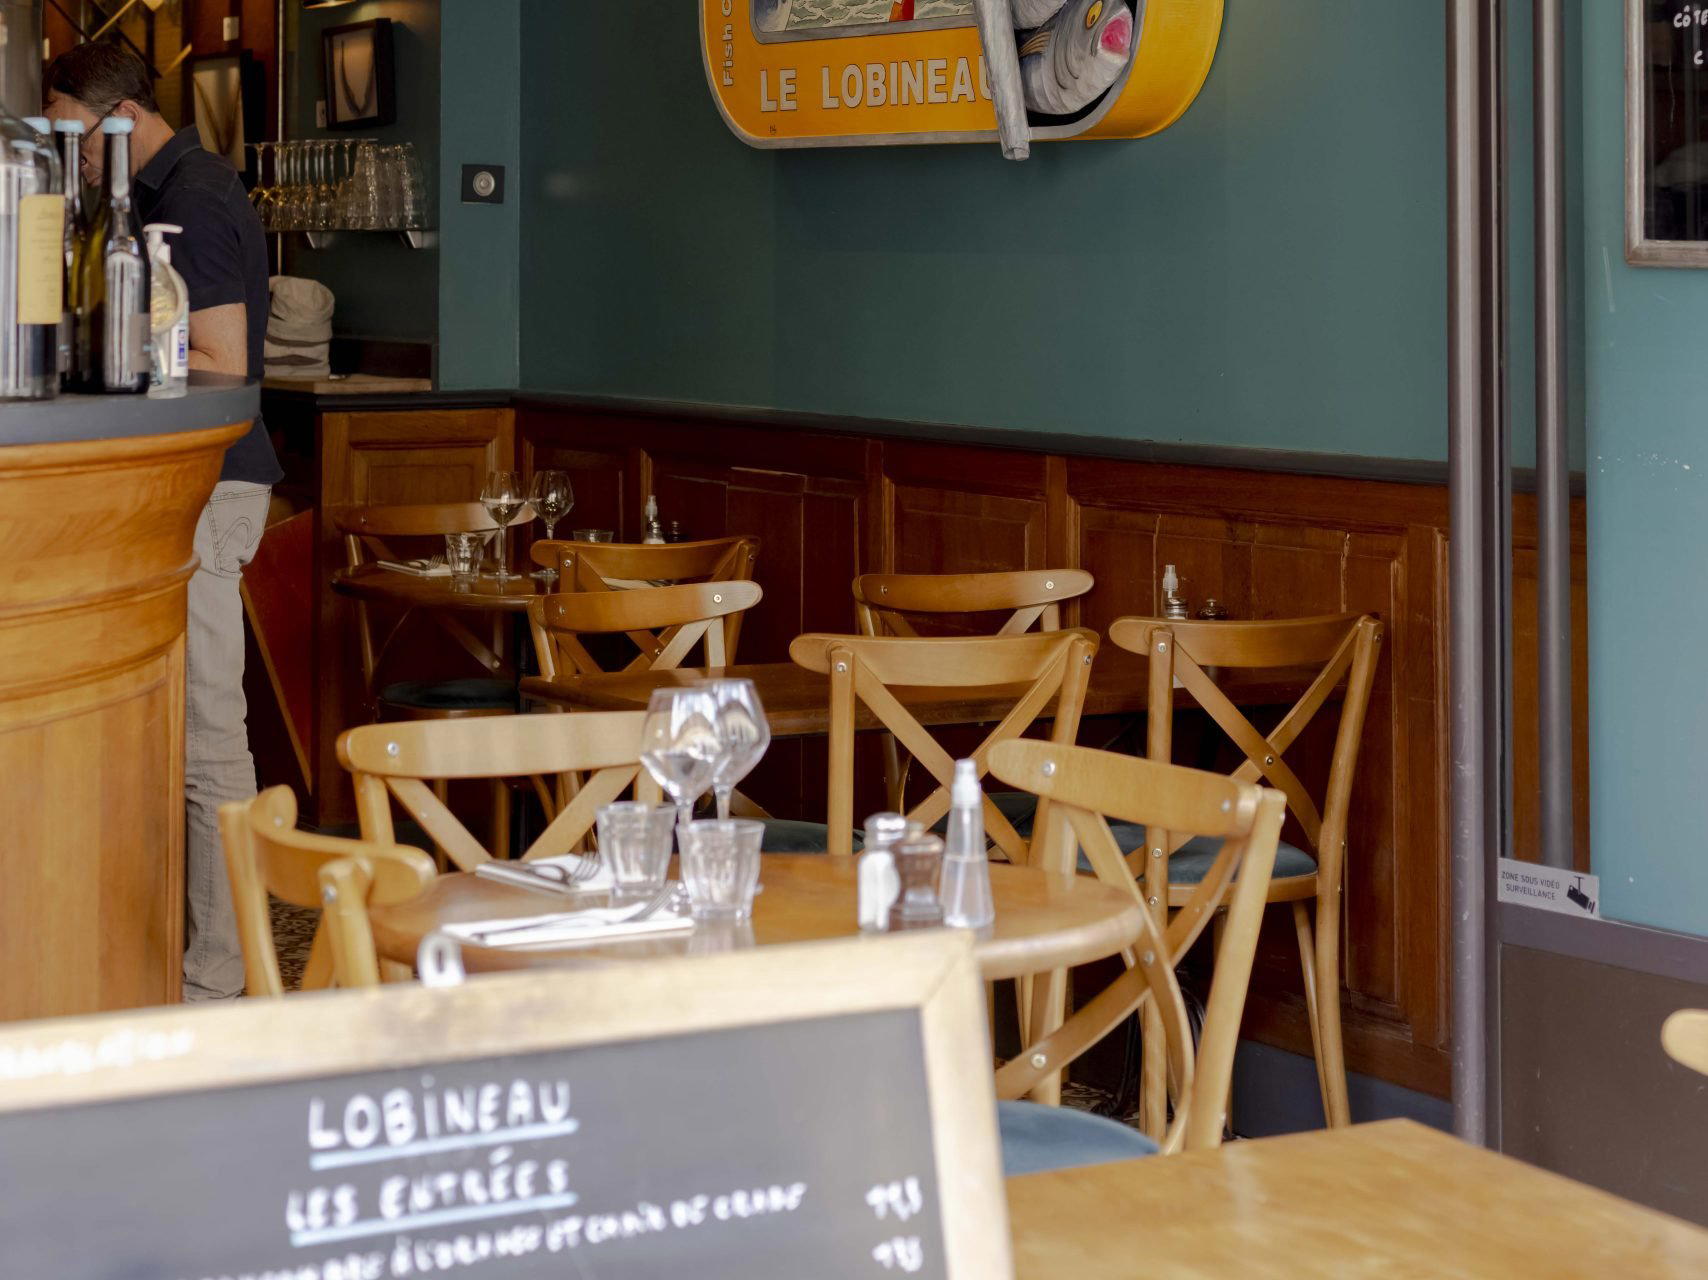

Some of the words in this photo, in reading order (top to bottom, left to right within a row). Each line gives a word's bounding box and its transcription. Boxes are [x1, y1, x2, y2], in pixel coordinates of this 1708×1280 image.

[722, 23, 734, 87] Fish
[760, 69, 798, 112] LE
[1501, 871, 1519, 882] ZONE
[1520, 875, 1538, 886] SOUS
[1505, 883, 1556, 900] SURVEILLANCE
[285, 1184, 358, 1232] LES
